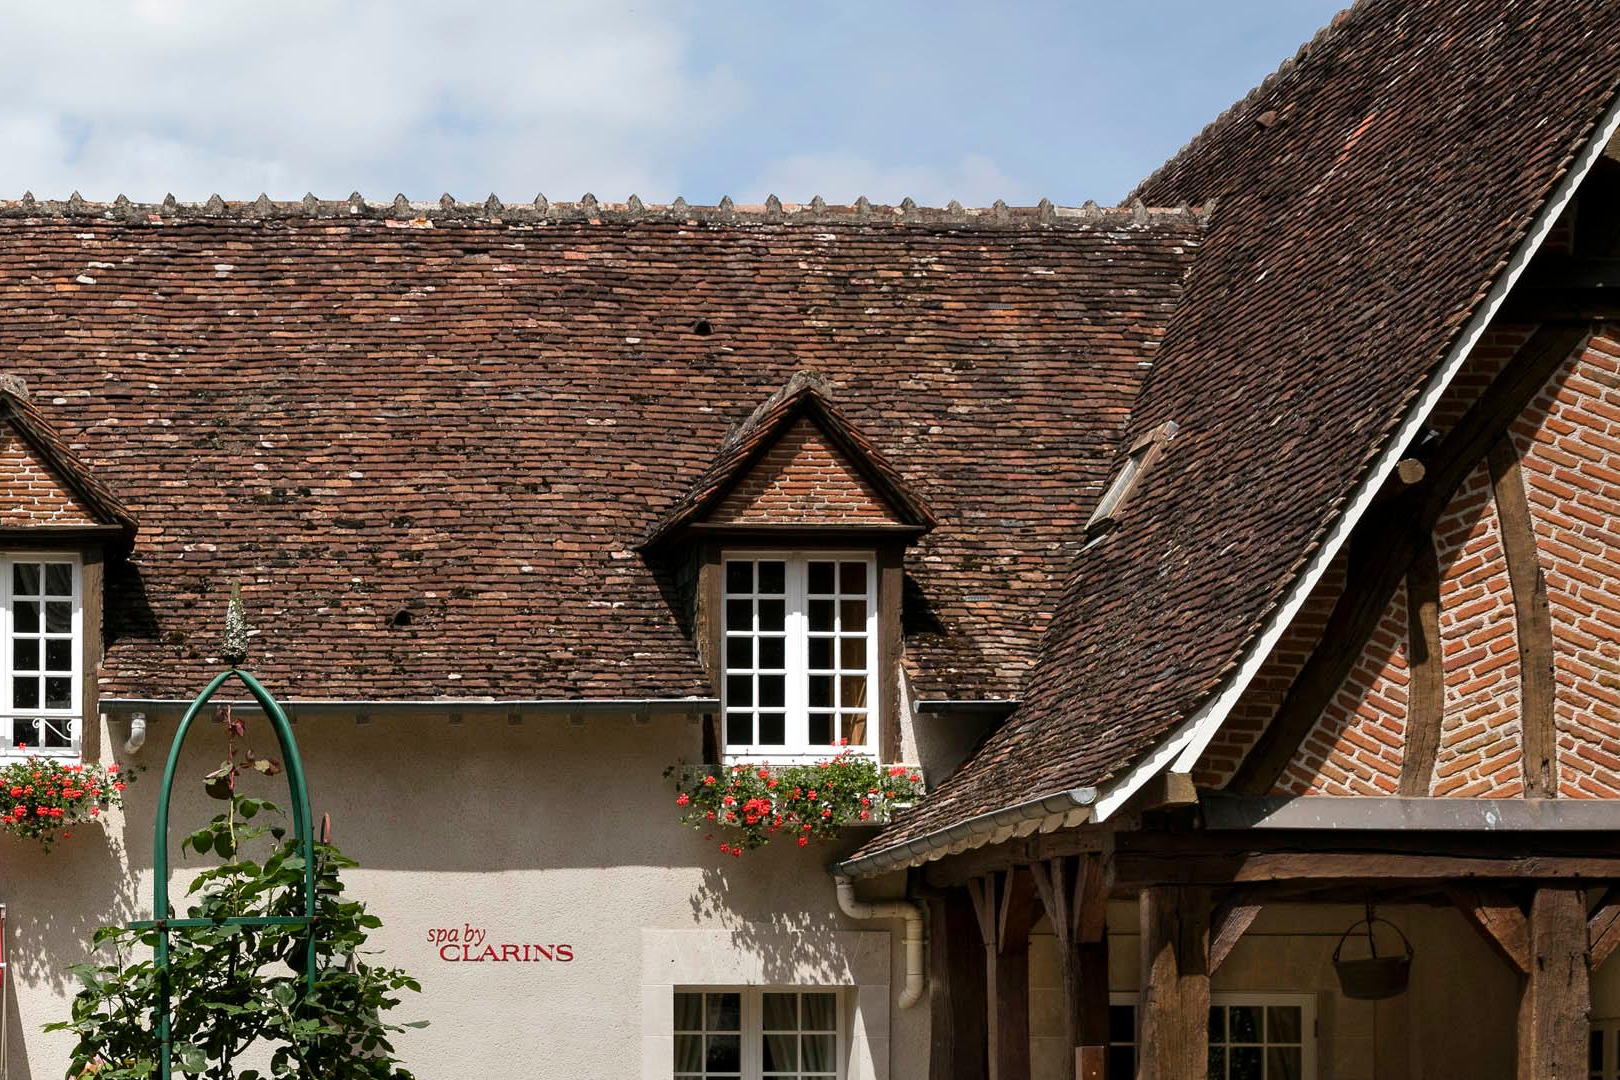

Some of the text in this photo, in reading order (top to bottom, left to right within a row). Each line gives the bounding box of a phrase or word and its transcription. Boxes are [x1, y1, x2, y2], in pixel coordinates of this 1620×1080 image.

[427, 923, 486, 946] spa by
[439, 943, 574, 962] CLARINS
